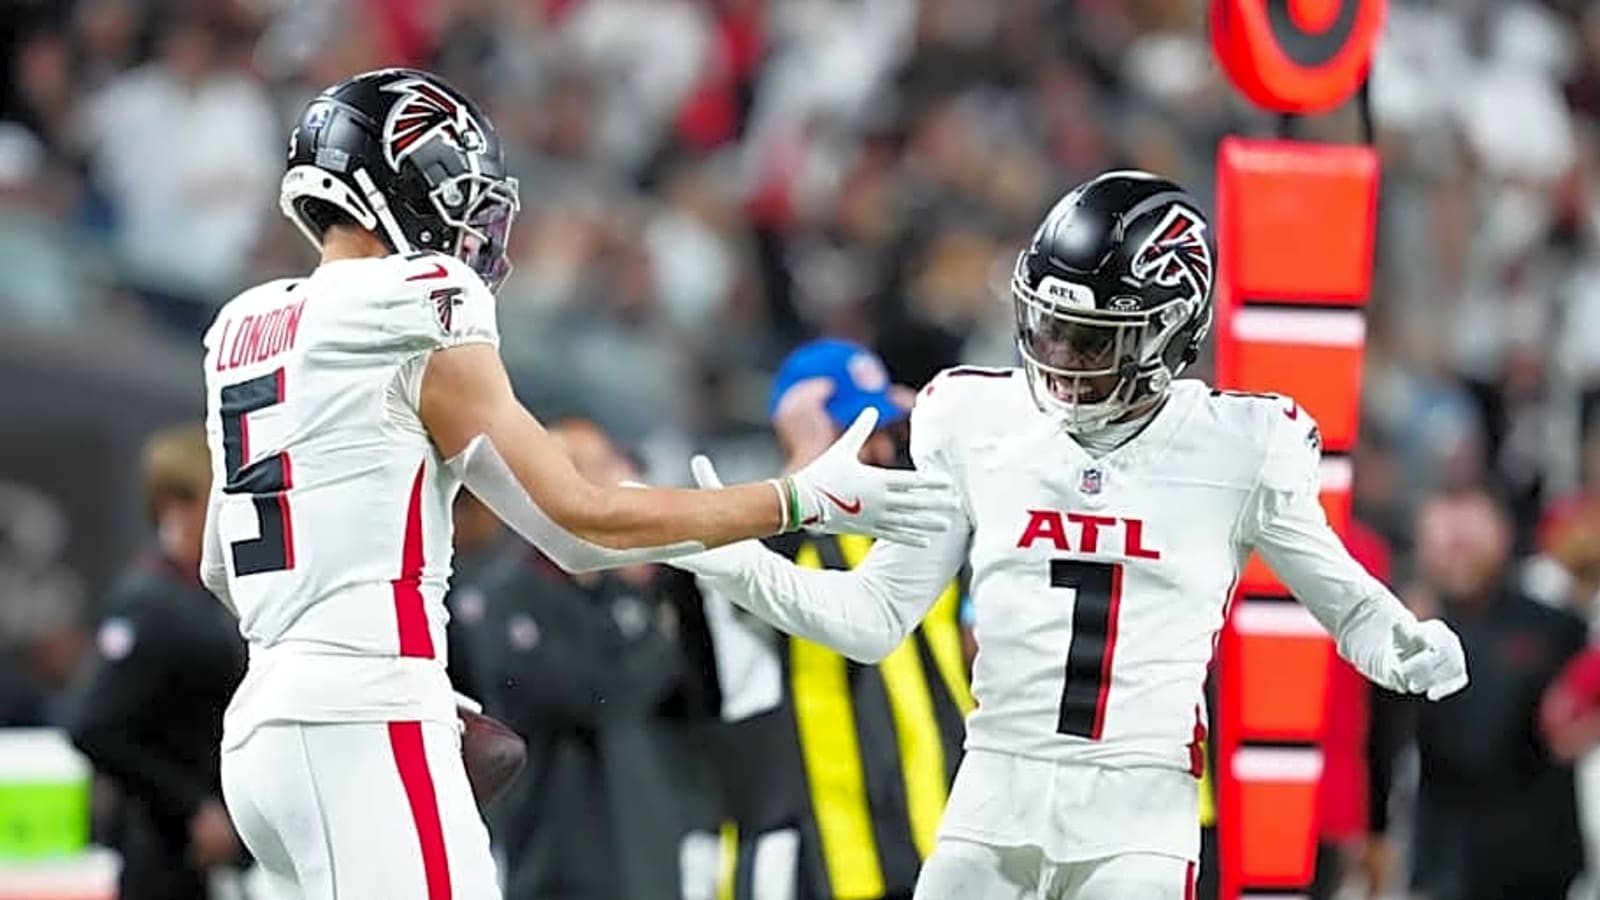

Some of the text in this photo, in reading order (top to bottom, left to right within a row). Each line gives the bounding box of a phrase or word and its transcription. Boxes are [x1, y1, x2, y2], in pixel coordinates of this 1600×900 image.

[216, 298, 306, 372] LONDON
[220, 366, 295, 577] 5
[1016, 509, 1160, 560] ATL
[1050, 559, 1122, 742] 1
